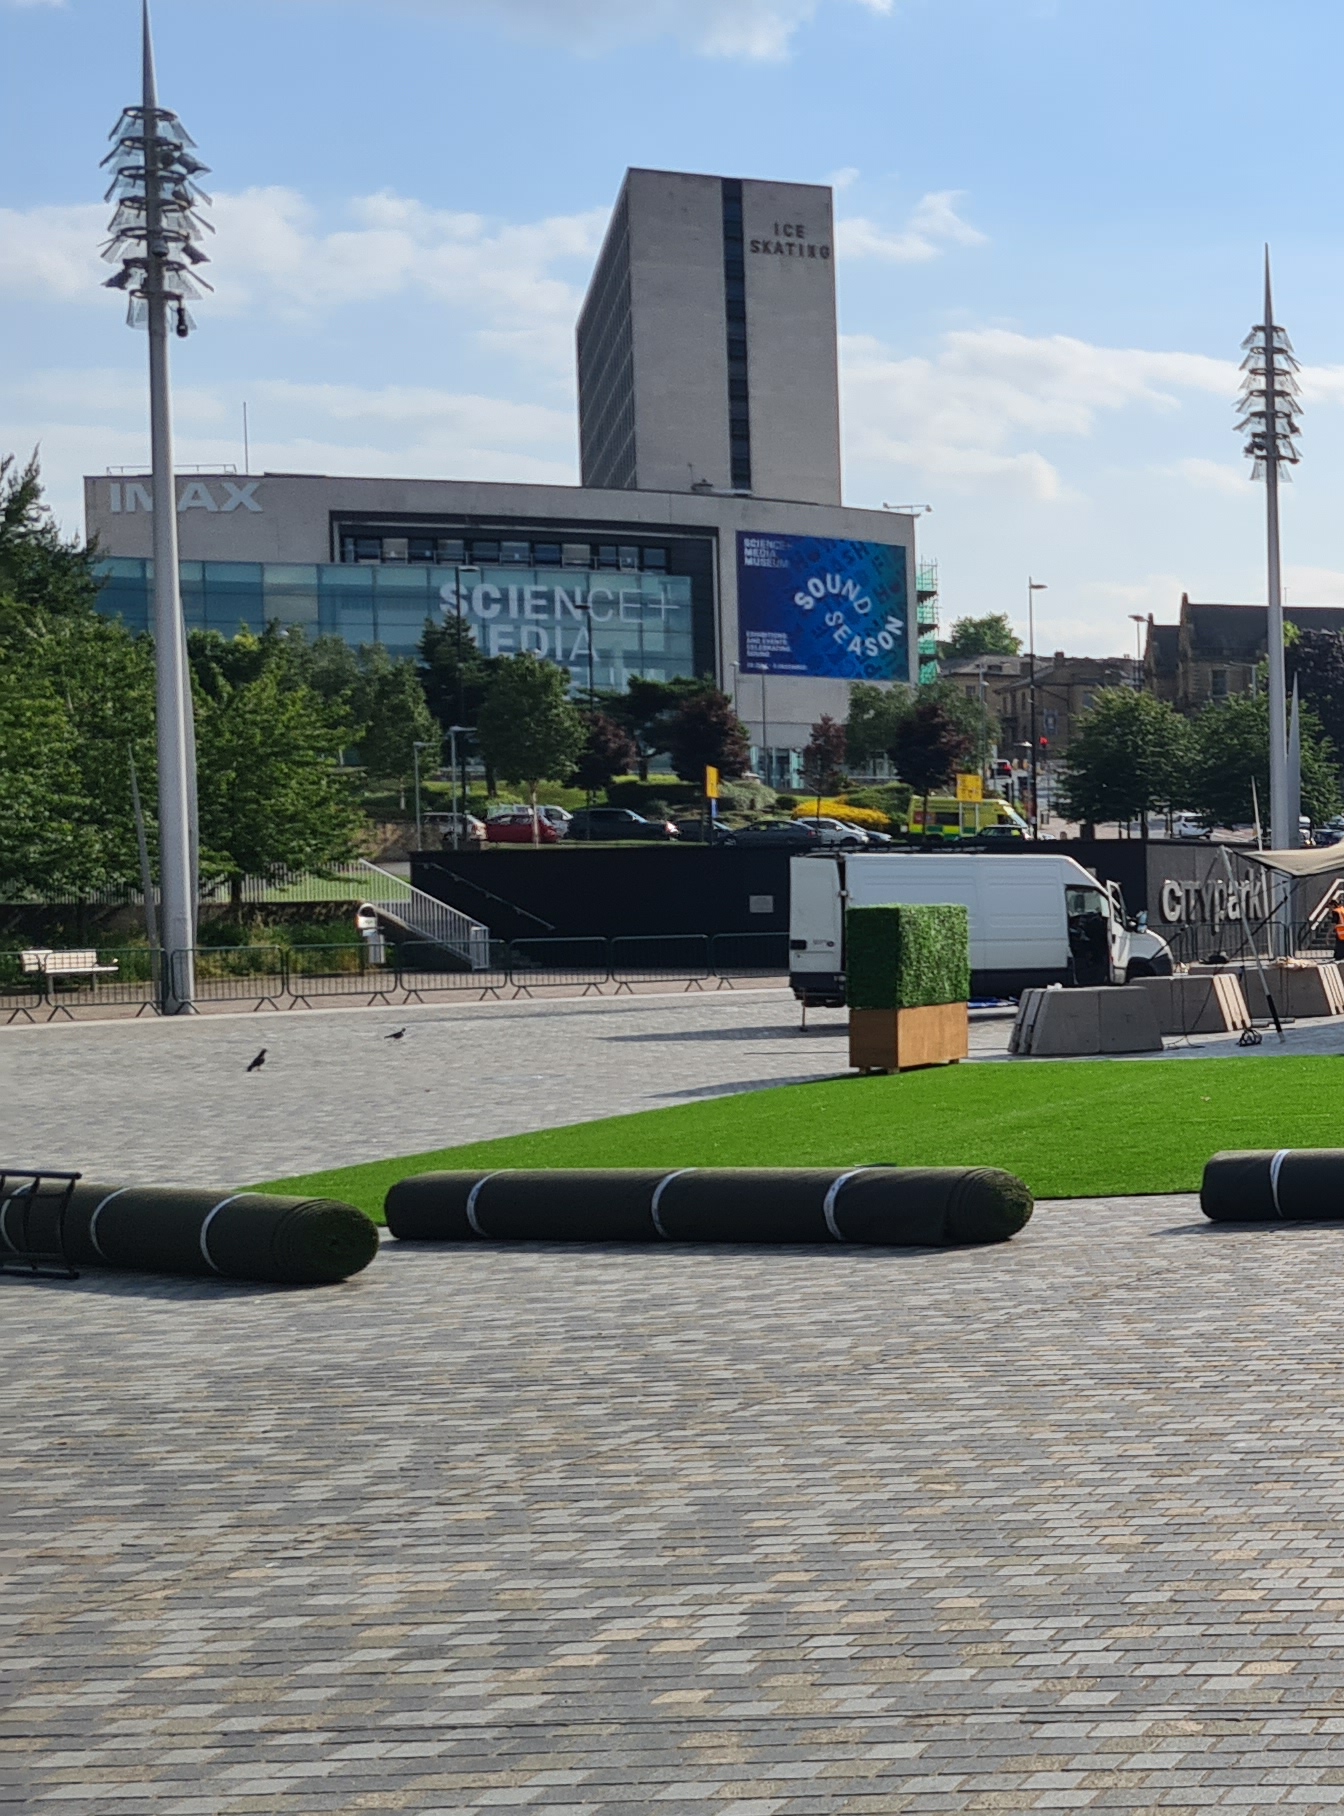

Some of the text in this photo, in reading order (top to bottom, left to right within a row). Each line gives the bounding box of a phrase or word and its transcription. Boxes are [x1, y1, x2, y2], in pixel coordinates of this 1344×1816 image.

[750, 240, 830, 259] SKATING
[774, 222, 805, 239] ICE
[794, 573, 871, 614] SOUND
[473, 623, 599, 662] EDIA
[825, 611, 904, 656] SEASON
